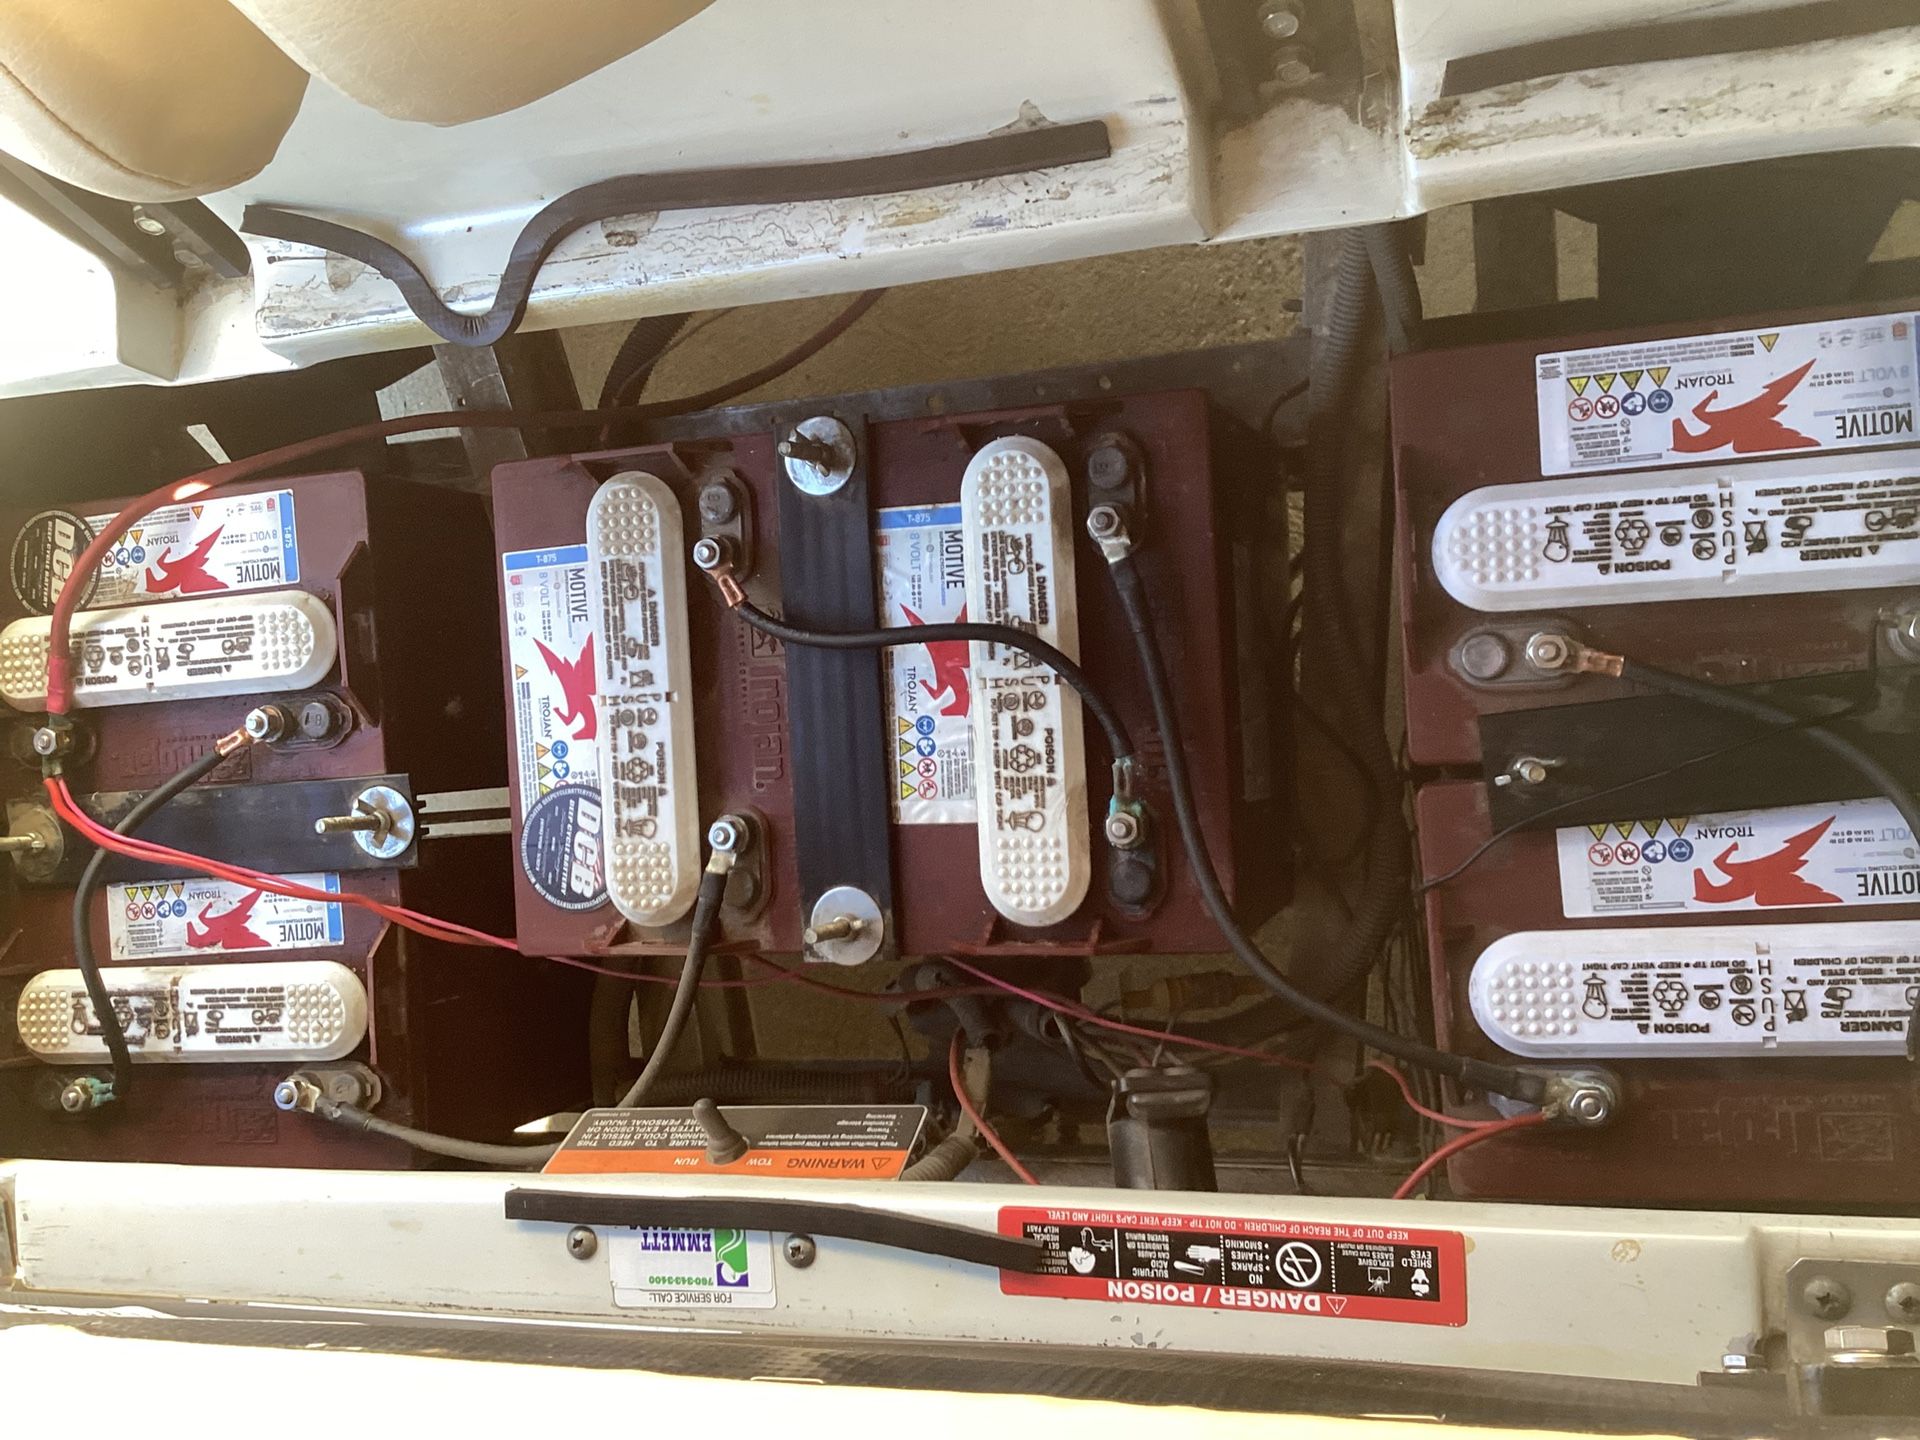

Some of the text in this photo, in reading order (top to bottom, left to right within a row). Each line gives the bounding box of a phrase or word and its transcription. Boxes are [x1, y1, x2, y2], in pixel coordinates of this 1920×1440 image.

[1858, 364, 1910, 382] 8 VOLT
[1678, 373, 1734, 388] TROJAN
[1835, 409, 1912, 439] MOTIVE
[906, 514, 930, 524] T-875
[147, 534, 179, 546] TROJAN
[249, 530, 270, 542] VOLT
[272, 530, 277, 540] 8
[284, 526, 293, 548] T-875
[910, 532, 920, 540] 8
[44, 544, 52, 570] CYCLE
[910, 542, 921, 572] VOLT
[1800, 546, 1862, 561] DANGER
[536, 555, 557, 564] T-875
[944, 530, 964, 589] MOTIVE
[236, 562, 280, 583] MOTIVE
[1614, 560, 1670, 574] POISON
[42, 570, 50, 608] BATTERY
[540, 582, 550, 608] VOLT
[570, 568, 588, 622] MOTIVE
[1036, 576, 1049, 624] DANGER
[648, 602, 660, 646] DANGER
[86, 675, 117, 685] POISON
[907, 666, 917, 712] TROJAN
[541, 696, 552, 736] TROJAN
[1044, 728, 1056, 774] POISON
[656, 742, 666, 784] POISON
[1698, 826, 1754, 840] TROJAN
[560, 799, 575, 896] DEEP CYCLE BATTERY
[570, 798, 602, 898] DCB
[188, 890, 220, 900] TROJAN
[279, 922, 324, 942] MOTIVE
[1582, 962, 1608, 970] TIGHT
[1611, 962, 1628, 970] CAP
[1632, 962, 1655, 970] VENT
[1794, 958, 1841, 966] CHILDREN
[1654, 1022, 1710, 1033] POISON
[1840, 1021, 1903, 1032] DANGER
[746, 1158, 773, 1166] TOW
[786, 1158, 865, 1168] WARNING
[1026, 1224, 1060, 1234] HELP FAST
[1047, 1210, 1408, 1240] KEEP OUT OF THE REACH OF CHILDREN DO NOT TIP KEEP VENT CAPS TIGHT AND LEVEL
[640, 1232, 712, 1252] EMMETT
[1033, 1233, 1060, 1242] MEDICAL
[1126, 1240, 1136, 1248] OR
[1225, 1238, 1263, 1250] SMOKING
[1051, 1250, 1067, 1258] WITH
[1138, 1250, 1156, 1258] CAUSE
[1230, 1250, 1263, 1261] FLAMES
[1371, 1251, 1394, 1260] GASES
[1410, 1250, 1432, 1258] EYES
[1150, 1260, 1168, 1268] ACID
[1231, 1261, 1264, 1272] SPARKS
[1358, 1258, 1394, 1267] EXPLOSIVE
[1401, 1257, 1432, 1268] SHIELD
[1048, 1266, 1068, 1274] FLUSH
[1132, 1267, 1168, 1278] SULFURIC
[1248, 1274, 1263, 1284] NO
[1108, 1280, 1194, 1302] POISON
[649, 1292, 732, 1303] FOR SERVICE CALL:
[1219, 1288, 1320, 1312] DANGER
